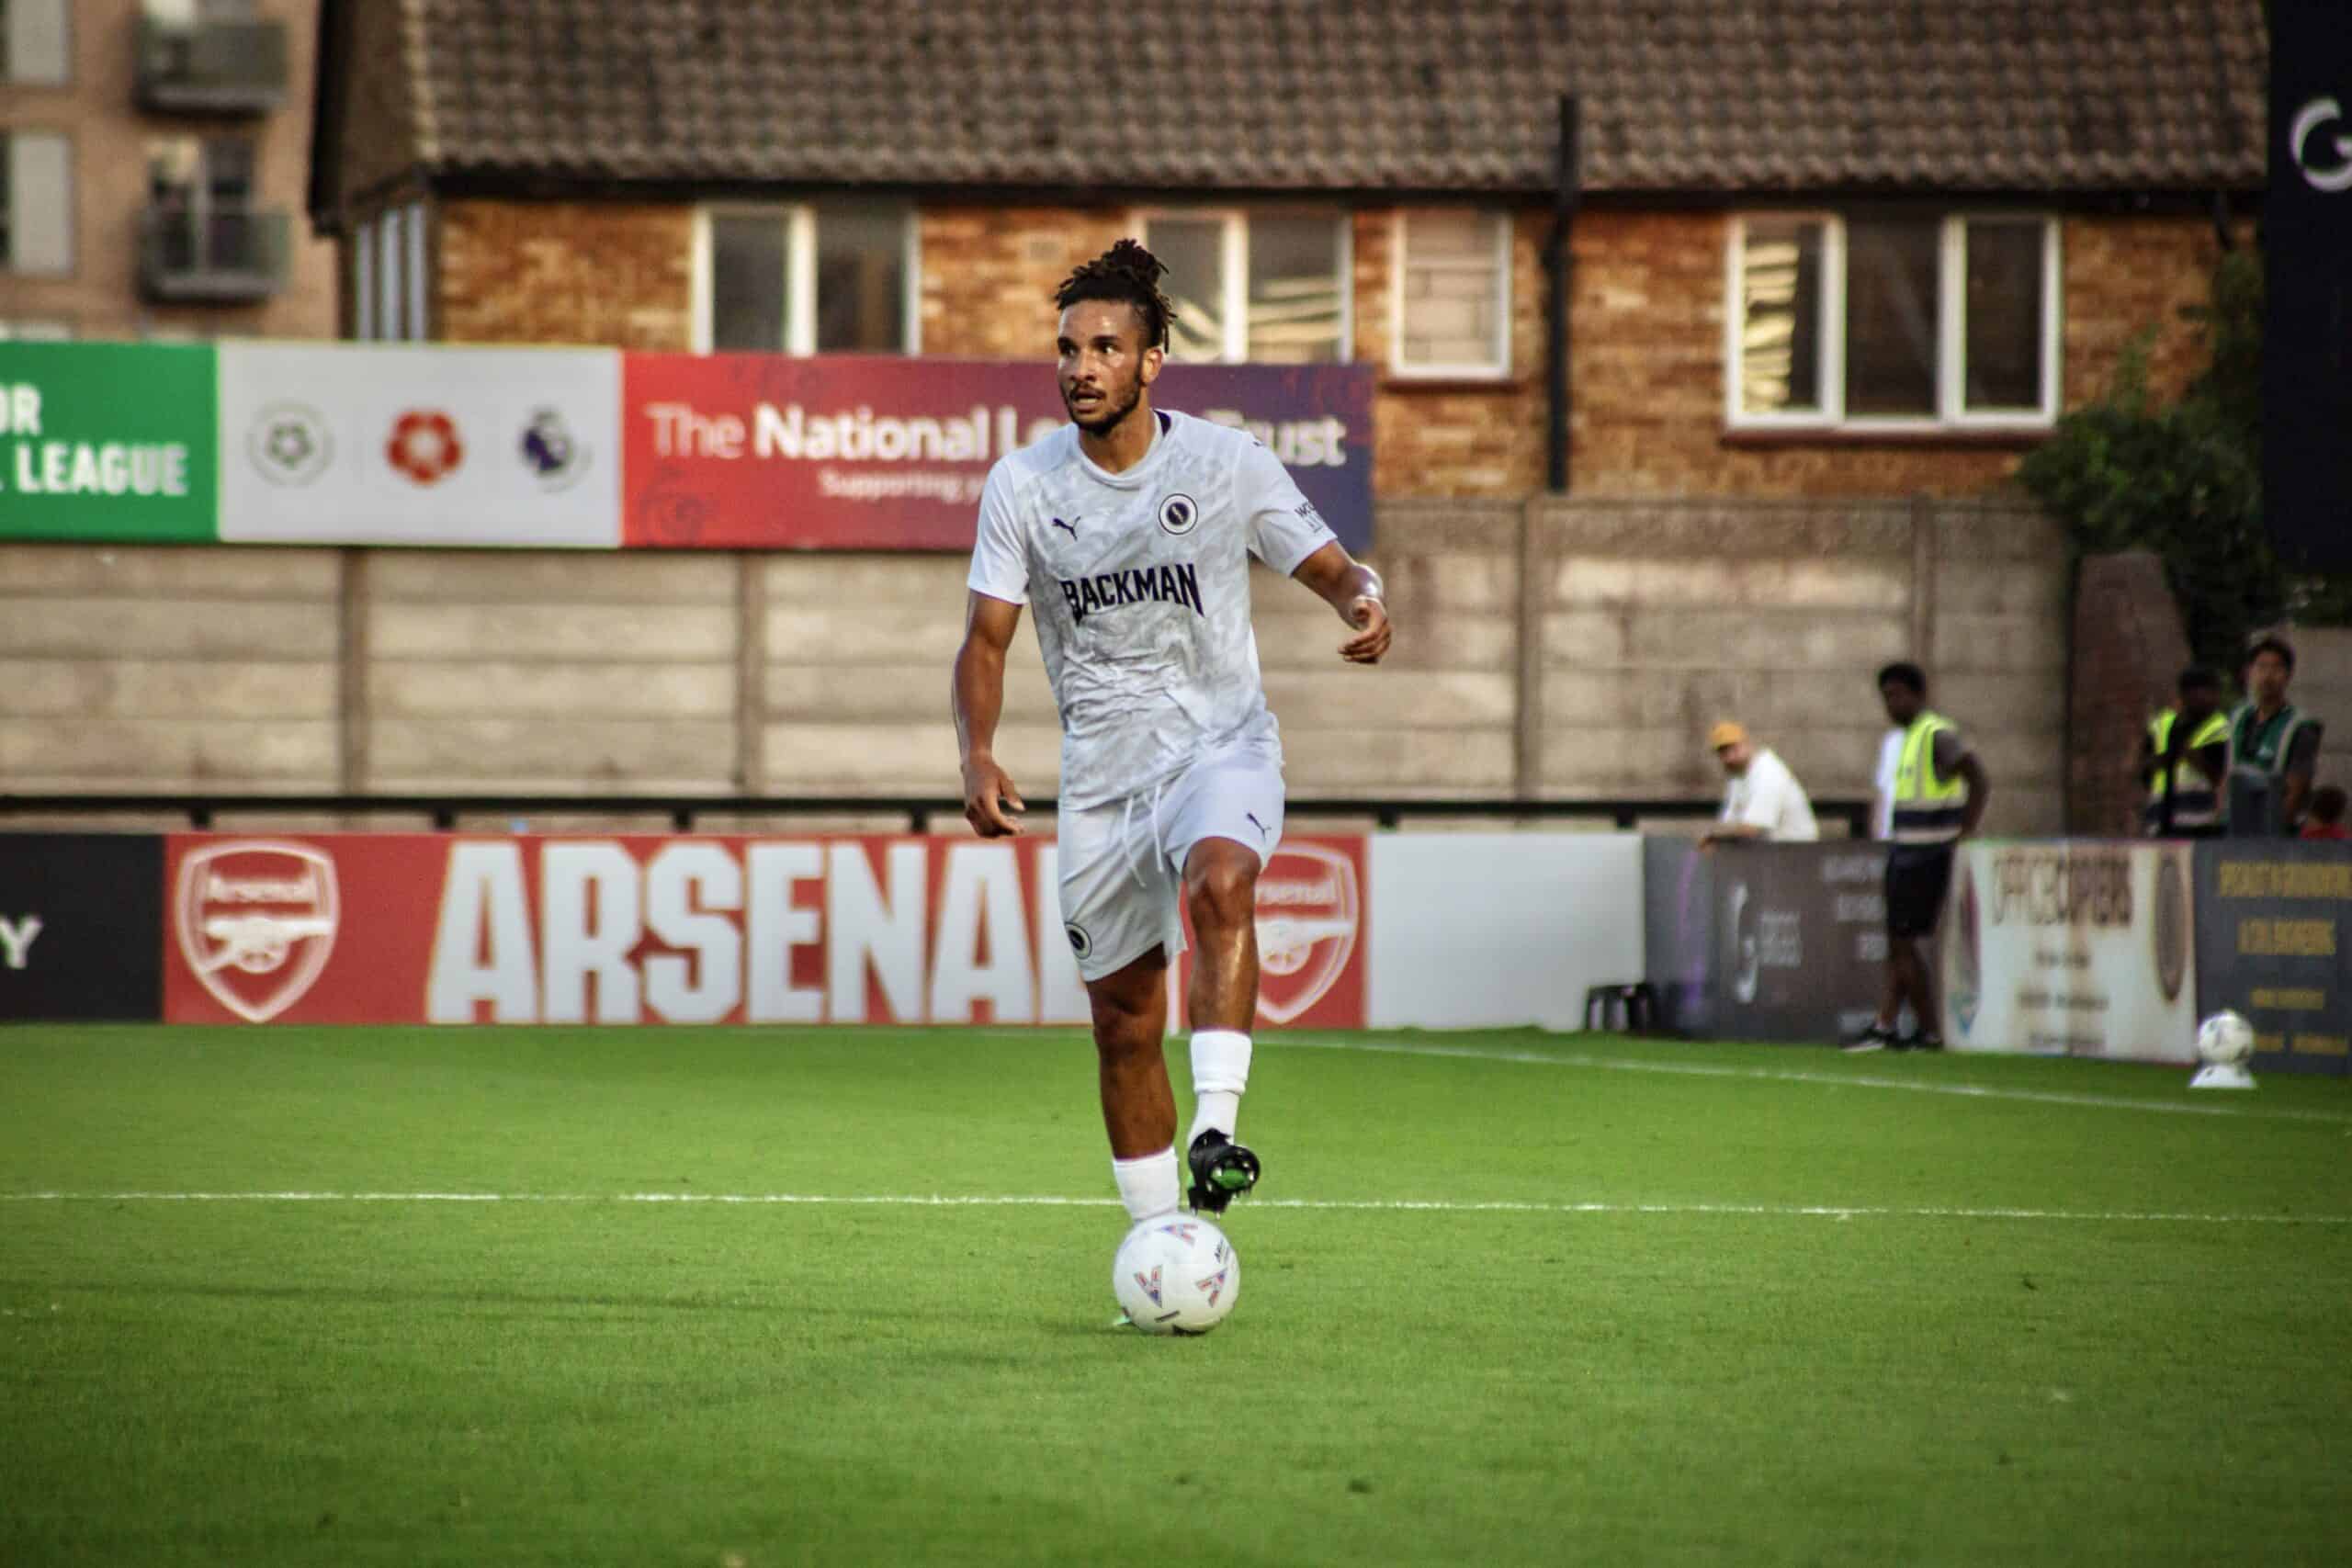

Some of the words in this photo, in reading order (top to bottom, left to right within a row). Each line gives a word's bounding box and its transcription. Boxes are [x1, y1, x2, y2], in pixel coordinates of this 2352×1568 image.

[646, 402, 745, 459] The
[754, 402, 989, 461] National
[17, 442, 188, 496] LEAGUE
[1059, 563, 1205, 626] BACKMAN
